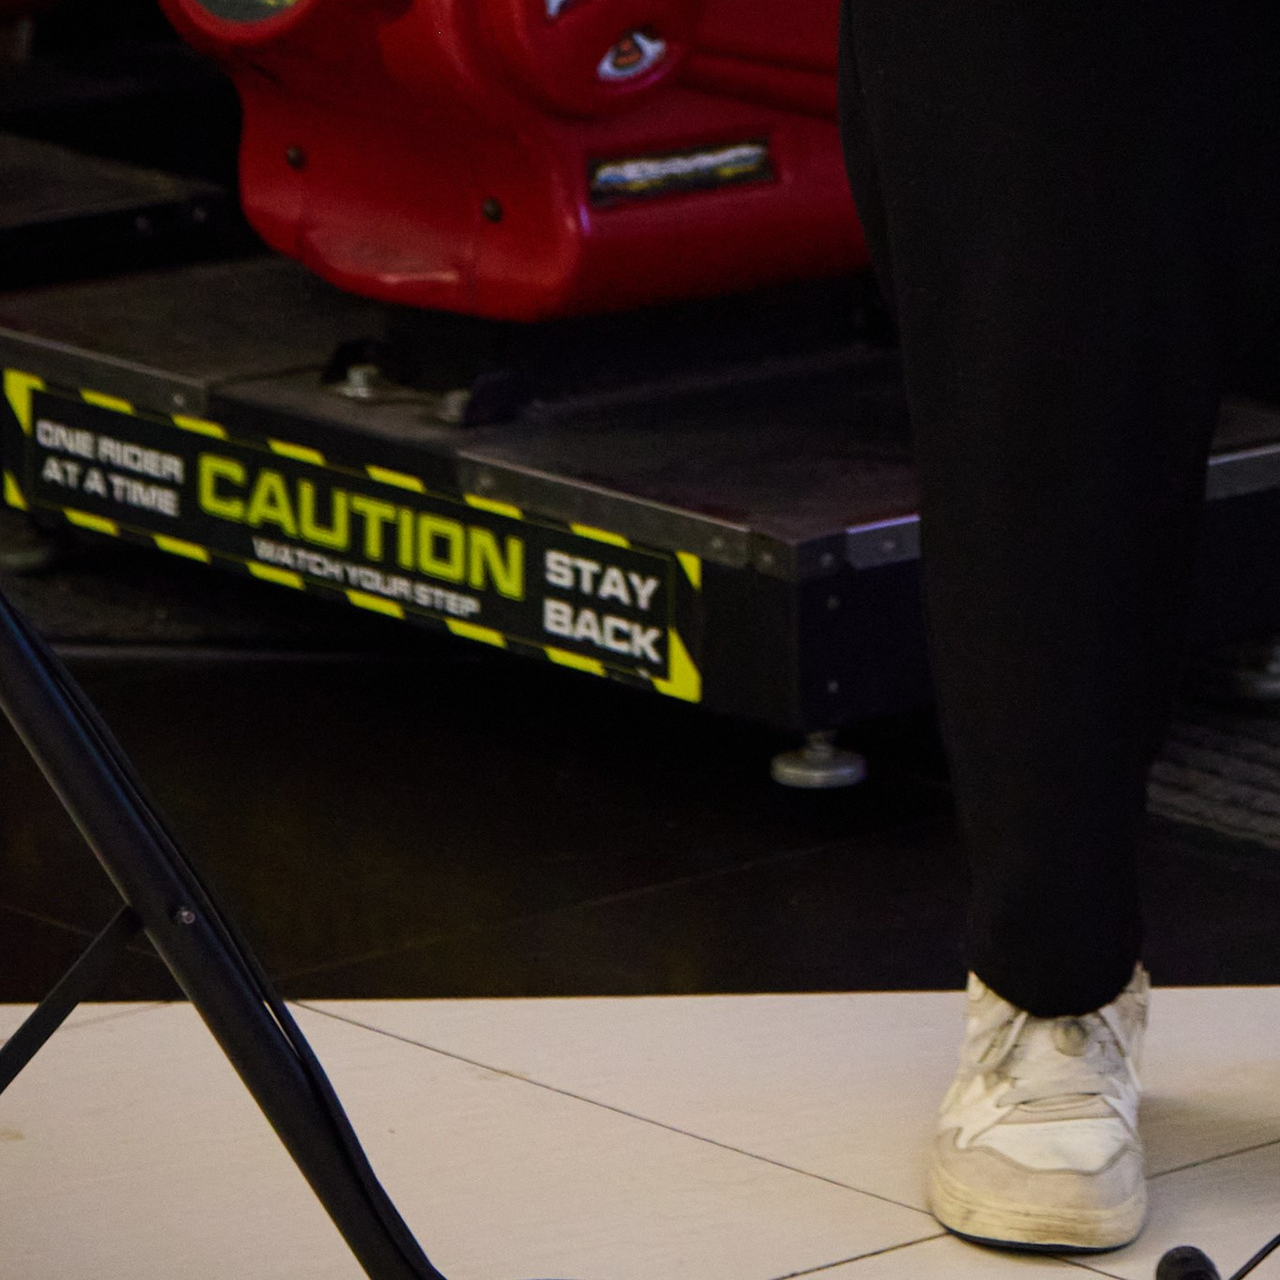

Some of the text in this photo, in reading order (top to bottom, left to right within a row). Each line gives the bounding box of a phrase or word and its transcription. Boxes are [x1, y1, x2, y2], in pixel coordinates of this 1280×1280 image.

[36, 418, 185, 486] ONE RIDER
[41, 455, 180, 518] AT A TIME
[197, 451, 526, 603] CAUTION
[251, 537, 482, 619] WATCH YOUR STEP
[544, 548, 662, 612] STAY
[542, 597, 663, 665] BACK
